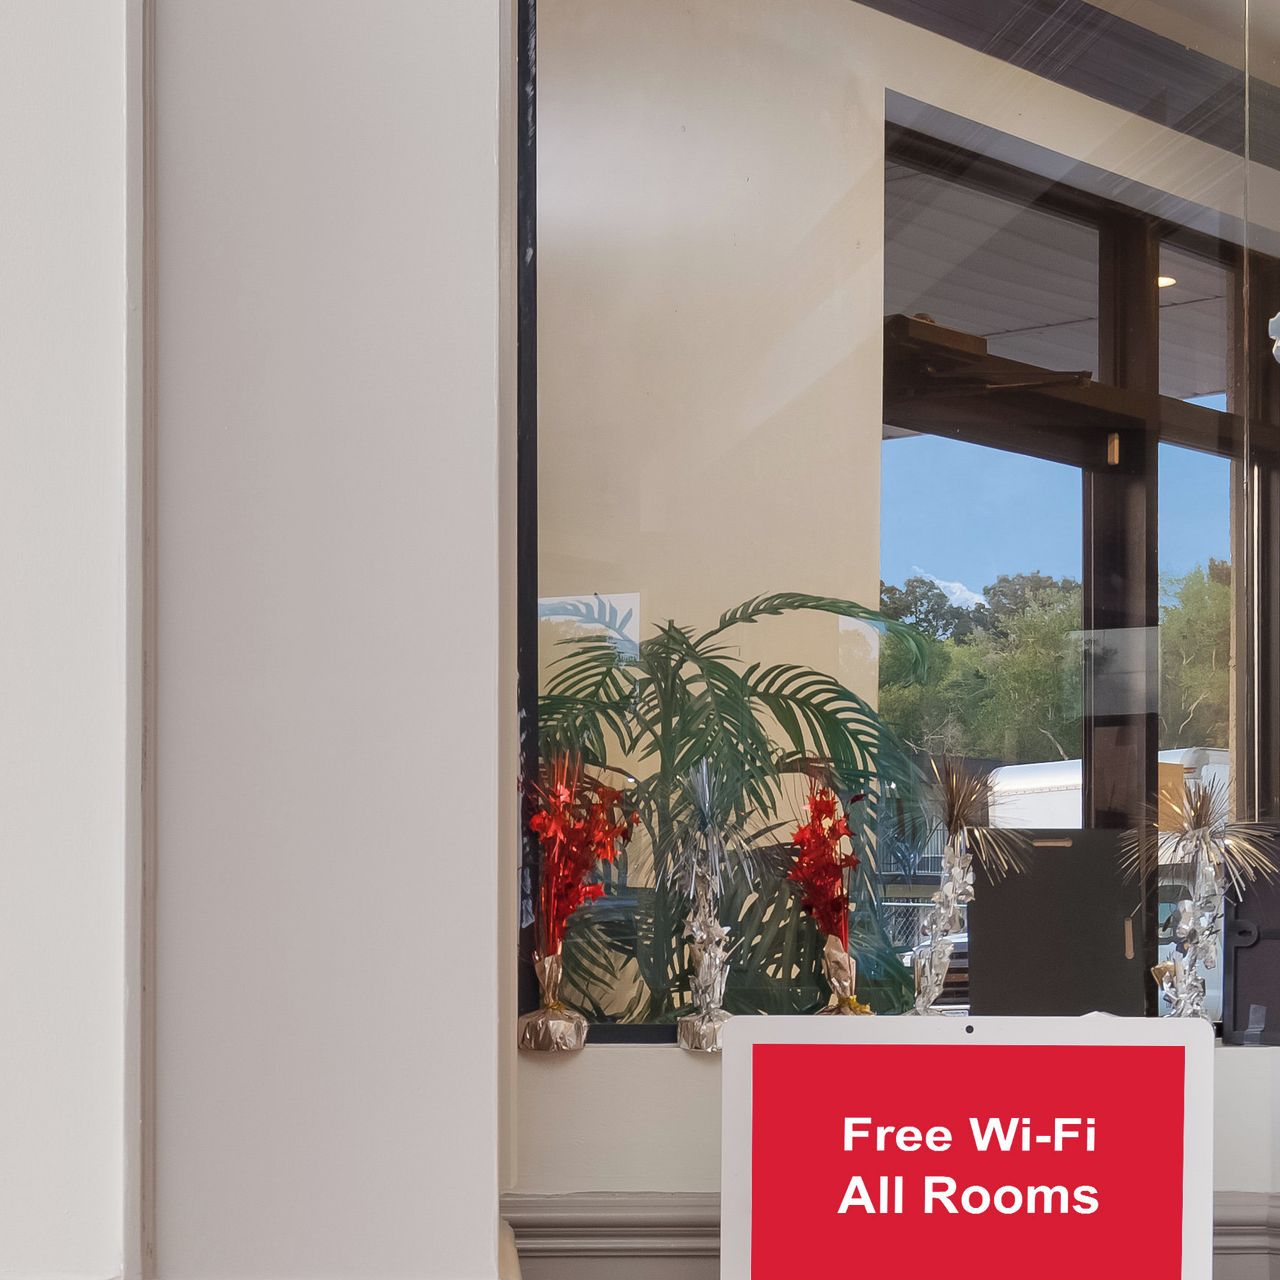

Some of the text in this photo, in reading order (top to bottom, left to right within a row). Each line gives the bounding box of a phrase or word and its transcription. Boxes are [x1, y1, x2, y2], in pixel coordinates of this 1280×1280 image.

[843, 1117, 1096, 1152] Free Wi-Fi
[837, 1175, 1099, 1215] All Rooms
